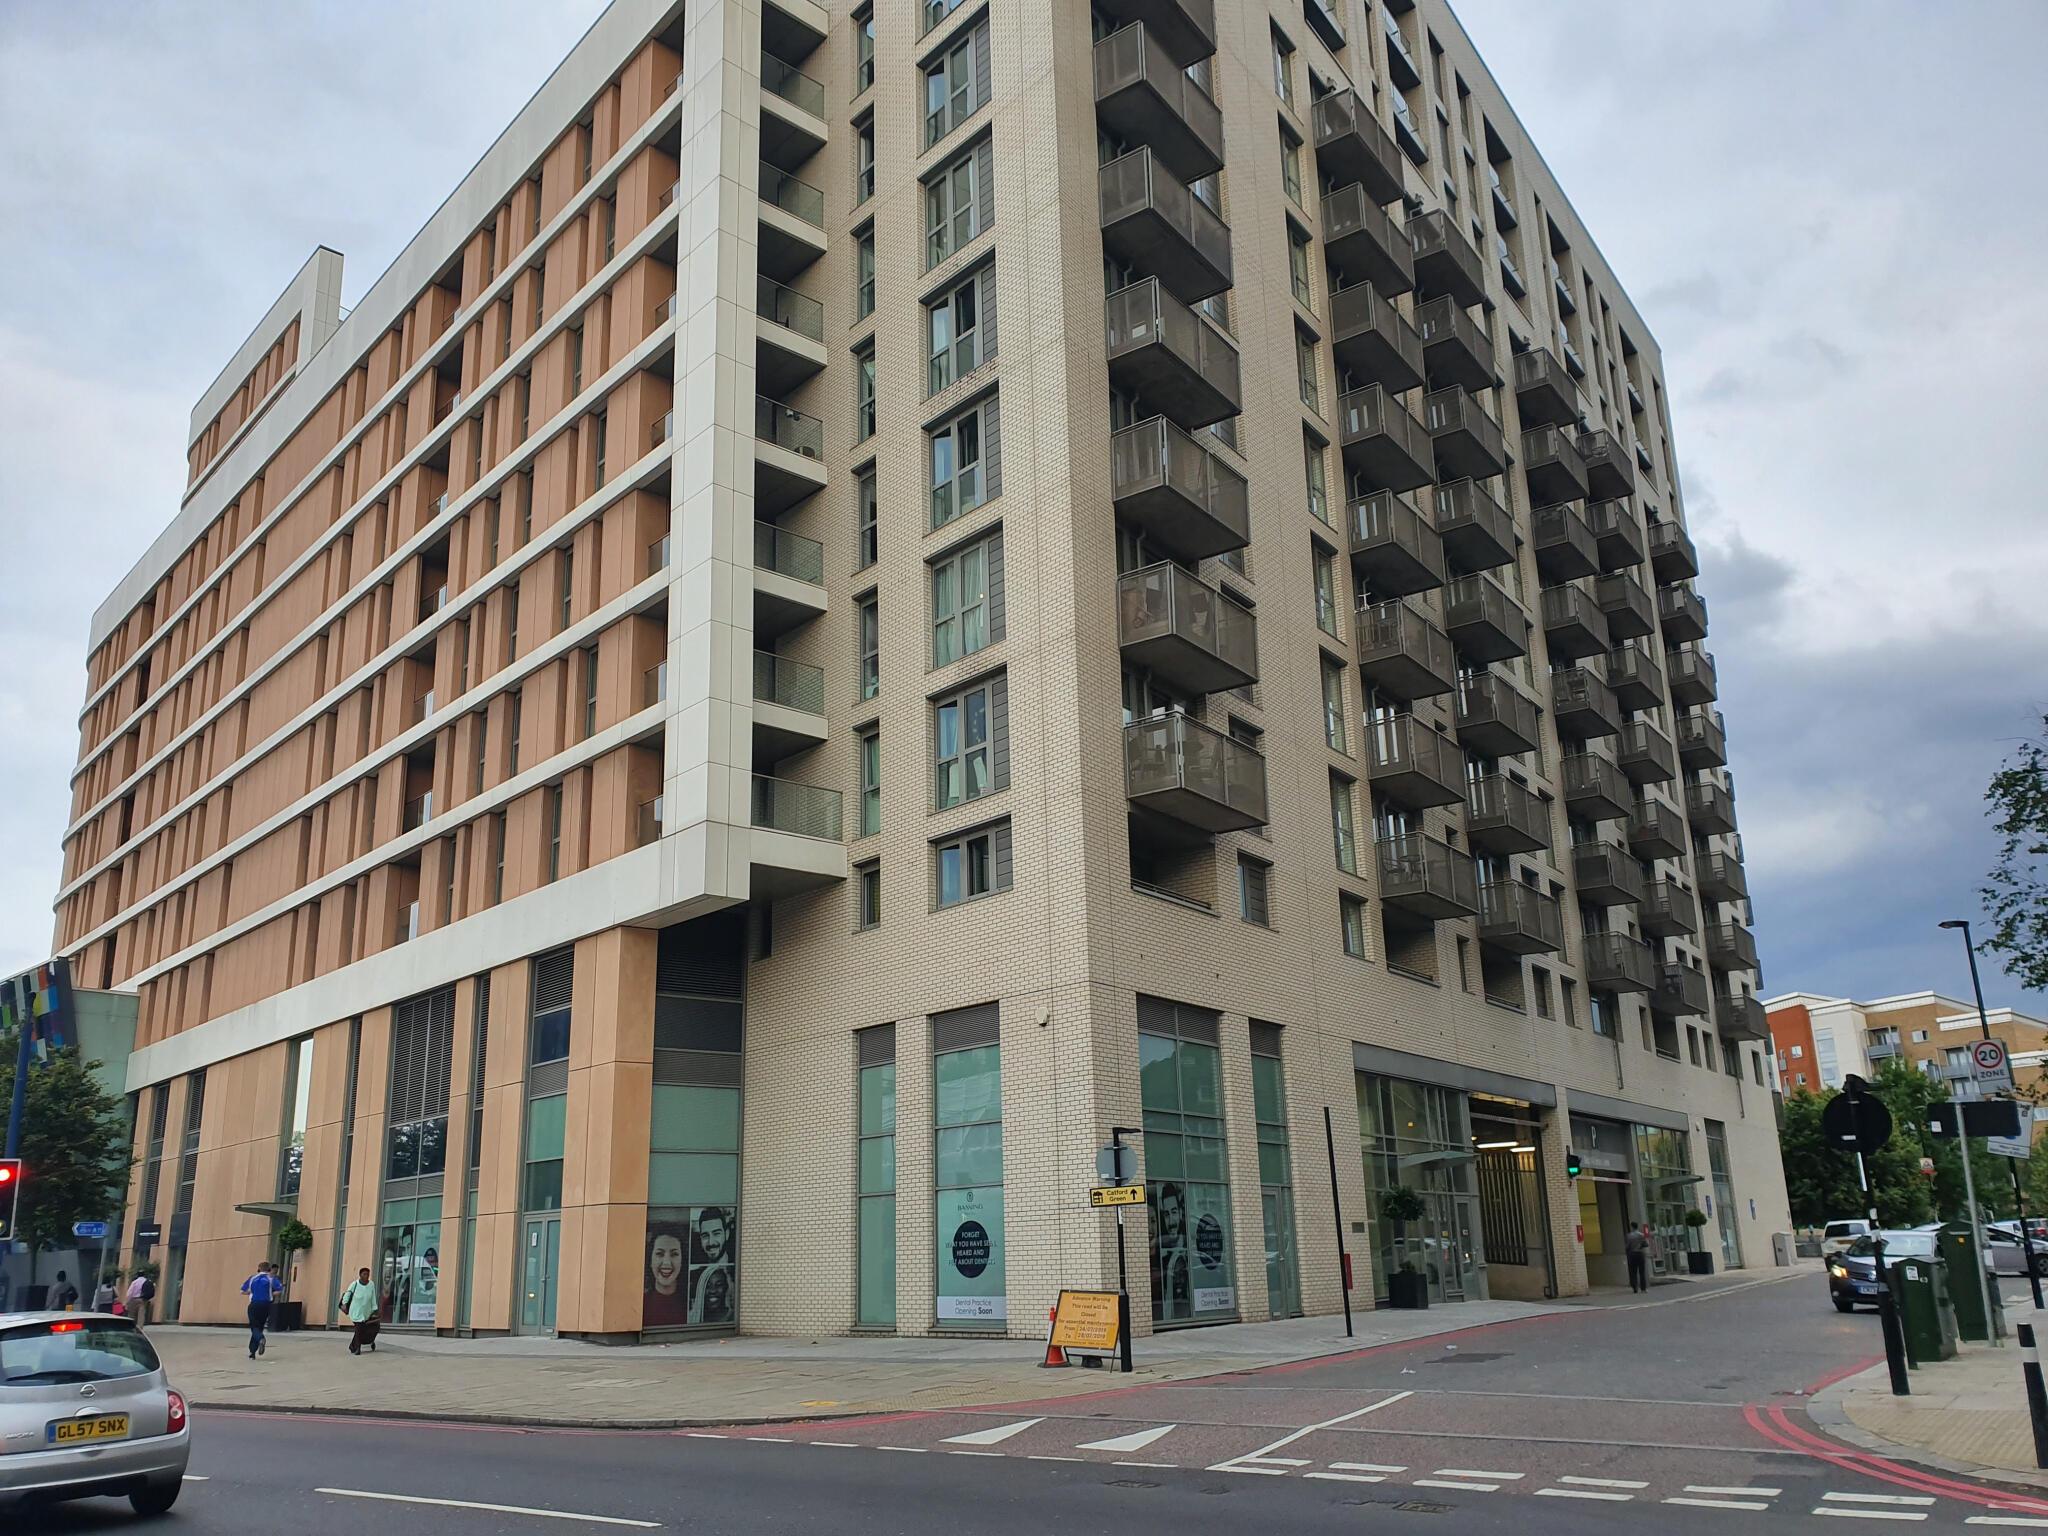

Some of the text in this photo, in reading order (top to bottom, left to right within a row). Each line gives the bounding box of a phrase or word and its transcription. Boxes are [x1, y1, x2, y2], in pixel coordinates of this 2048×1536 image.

[1980, 1049, 1998, 1061] 20
[1980, 1069, 2005, 1078] ZONE
[1591, 1126, 1597, 1148] P
[955, 1306, 992, 1316] Opening Soon
[58, 1418, 125, 1438] GL57 SNX
